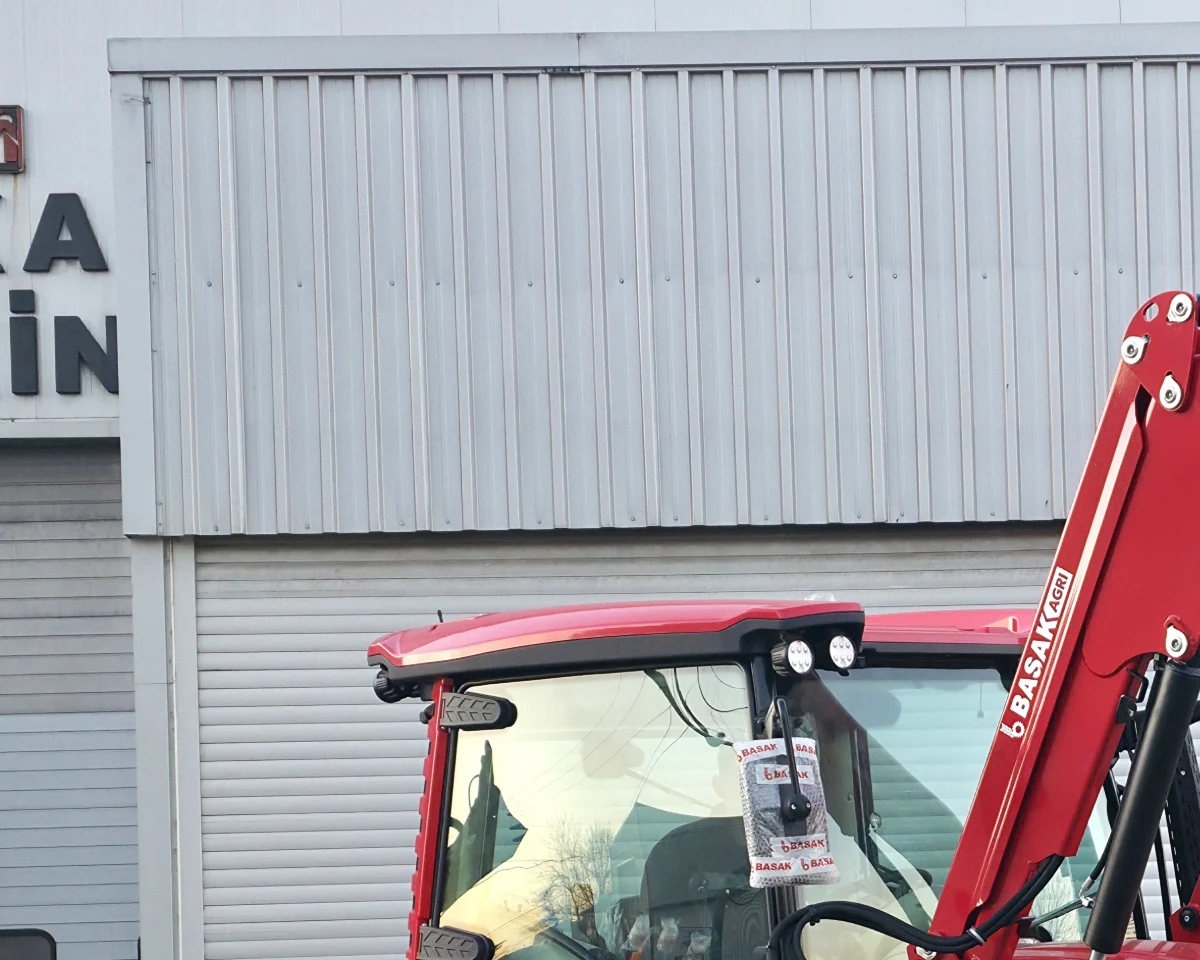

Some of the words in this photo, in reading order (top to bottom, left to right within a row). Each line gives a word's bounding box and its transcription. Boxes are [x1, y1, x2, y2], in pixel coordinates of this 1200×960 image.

[0, 192, 109, 273] A
[1009, 612, 1059, 719] BASAK
[1048, 572, 1069, 613] AGRI
[741, 743, 779, 757] BASAK
[774, 770, 809, 779] BAAK
[790, 839, 826, 850] BASAK
[755, 862, 792, 871] BASAK
